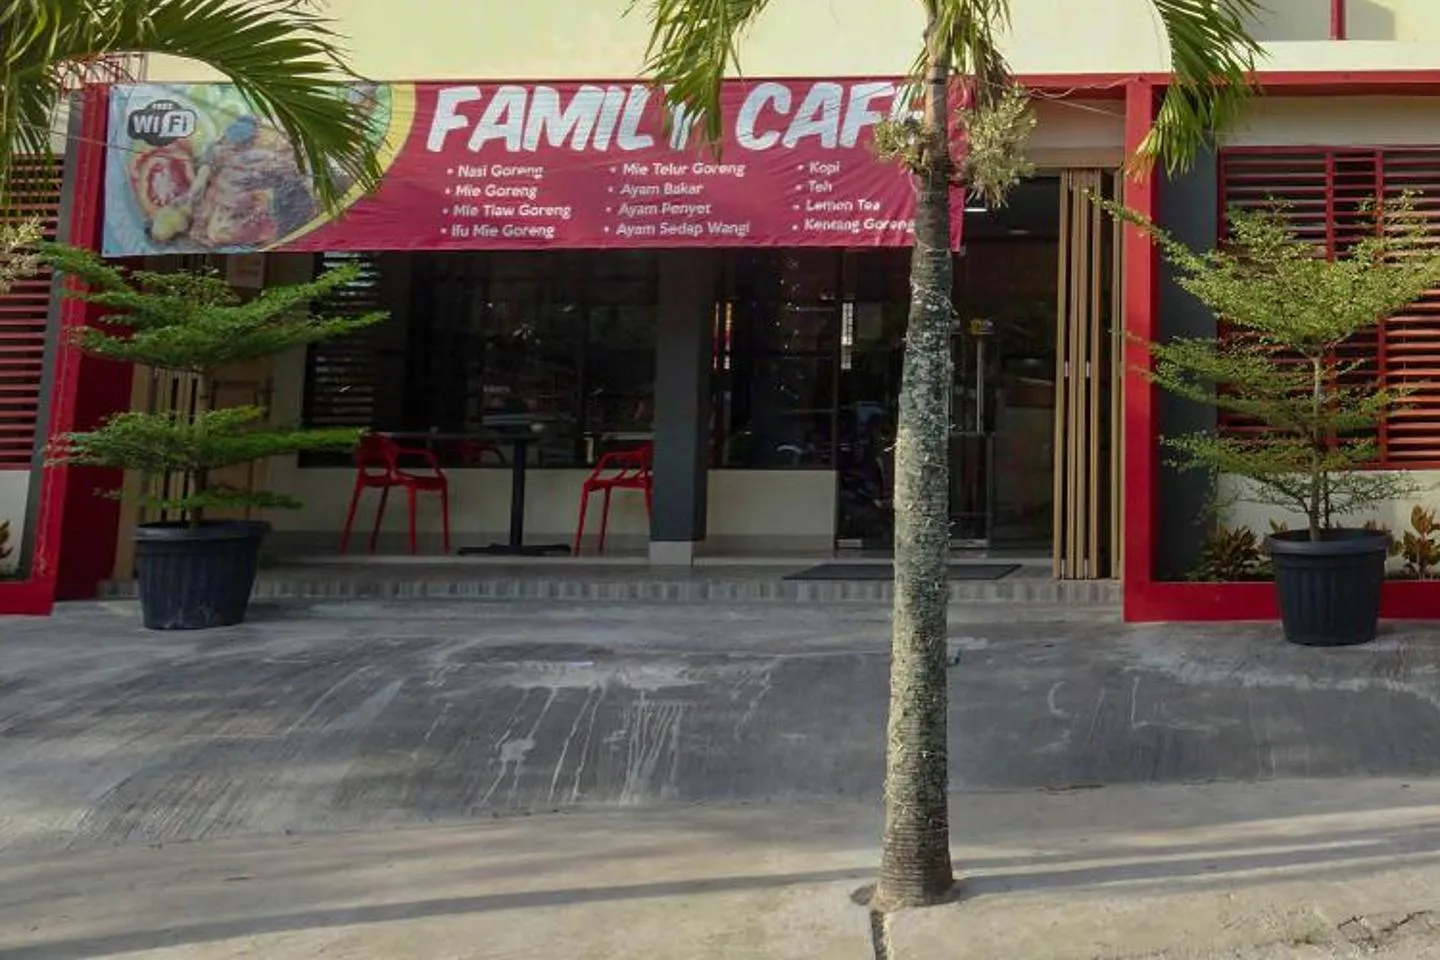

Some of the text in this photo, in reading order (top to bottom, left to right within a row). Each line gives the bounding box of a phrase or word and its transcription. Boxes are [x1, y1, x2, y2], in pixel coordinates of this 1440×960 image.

[458, 164, 544, 180] Nasi Goreng
[623, 162, 746, 178] Mie Telur Goreng
[809, 161, 840, 175] Kopi
[455, 184, 538, 200] Mie Goreng
[619, 182, 704, 198] Ayam Bakar
[808, 180, 833, 193] Teh
[453, 204, 572, 220] Mie Tiaw Goreng
[618, 202, 712, 218] Ayam Penyet
[806, 199, 881, 212] Lemon Tea
[473, 224, 499, 237] Mie
[502, 224, 555, 239] Goreng
[616, 220, 750, 238] Ayam Sedap Wangi
[804, 218, 915, 234] Kentang Goreng
